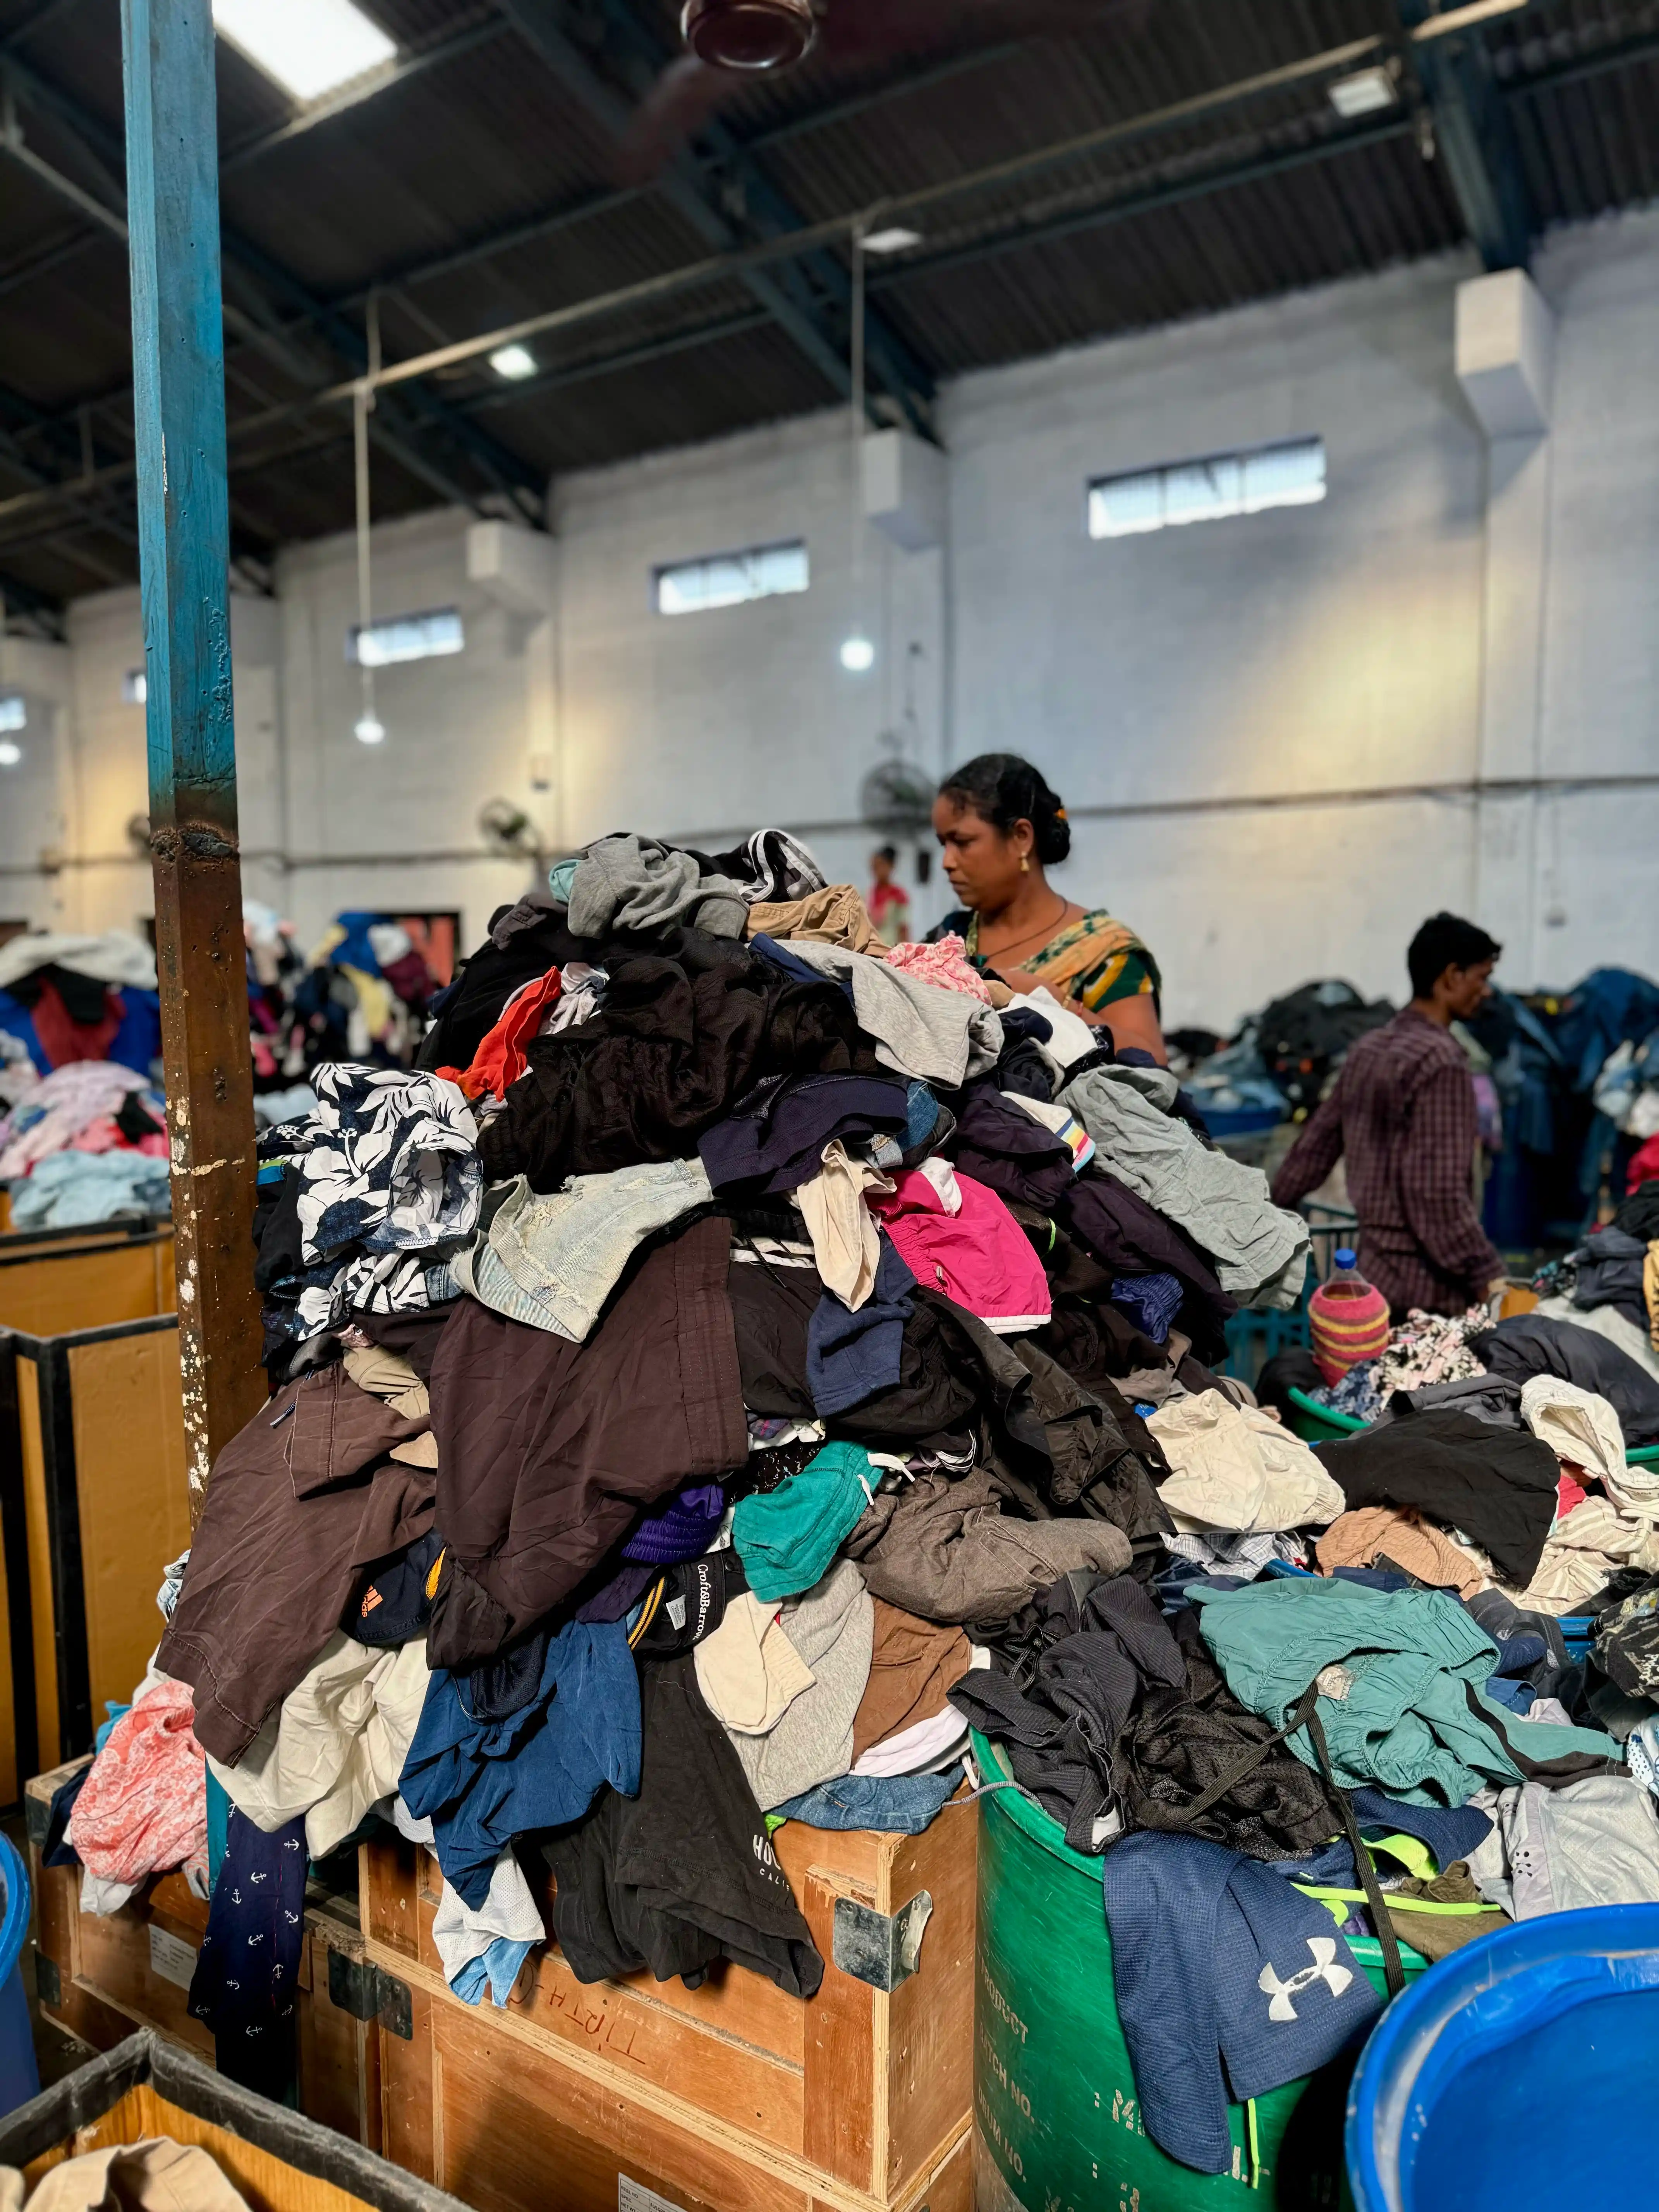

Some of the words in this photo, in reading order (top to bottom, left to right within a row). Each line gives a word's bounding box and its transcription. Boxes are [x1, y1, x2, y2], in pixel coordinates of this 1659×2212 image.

[981, 1956, 1028, 2044] PRODUCT
[978, 2082, 1001, 2147] DRUM
[1005, 2137, 1027, 2183] NO.
[1011, 2078, 1035, 2124] NO.
